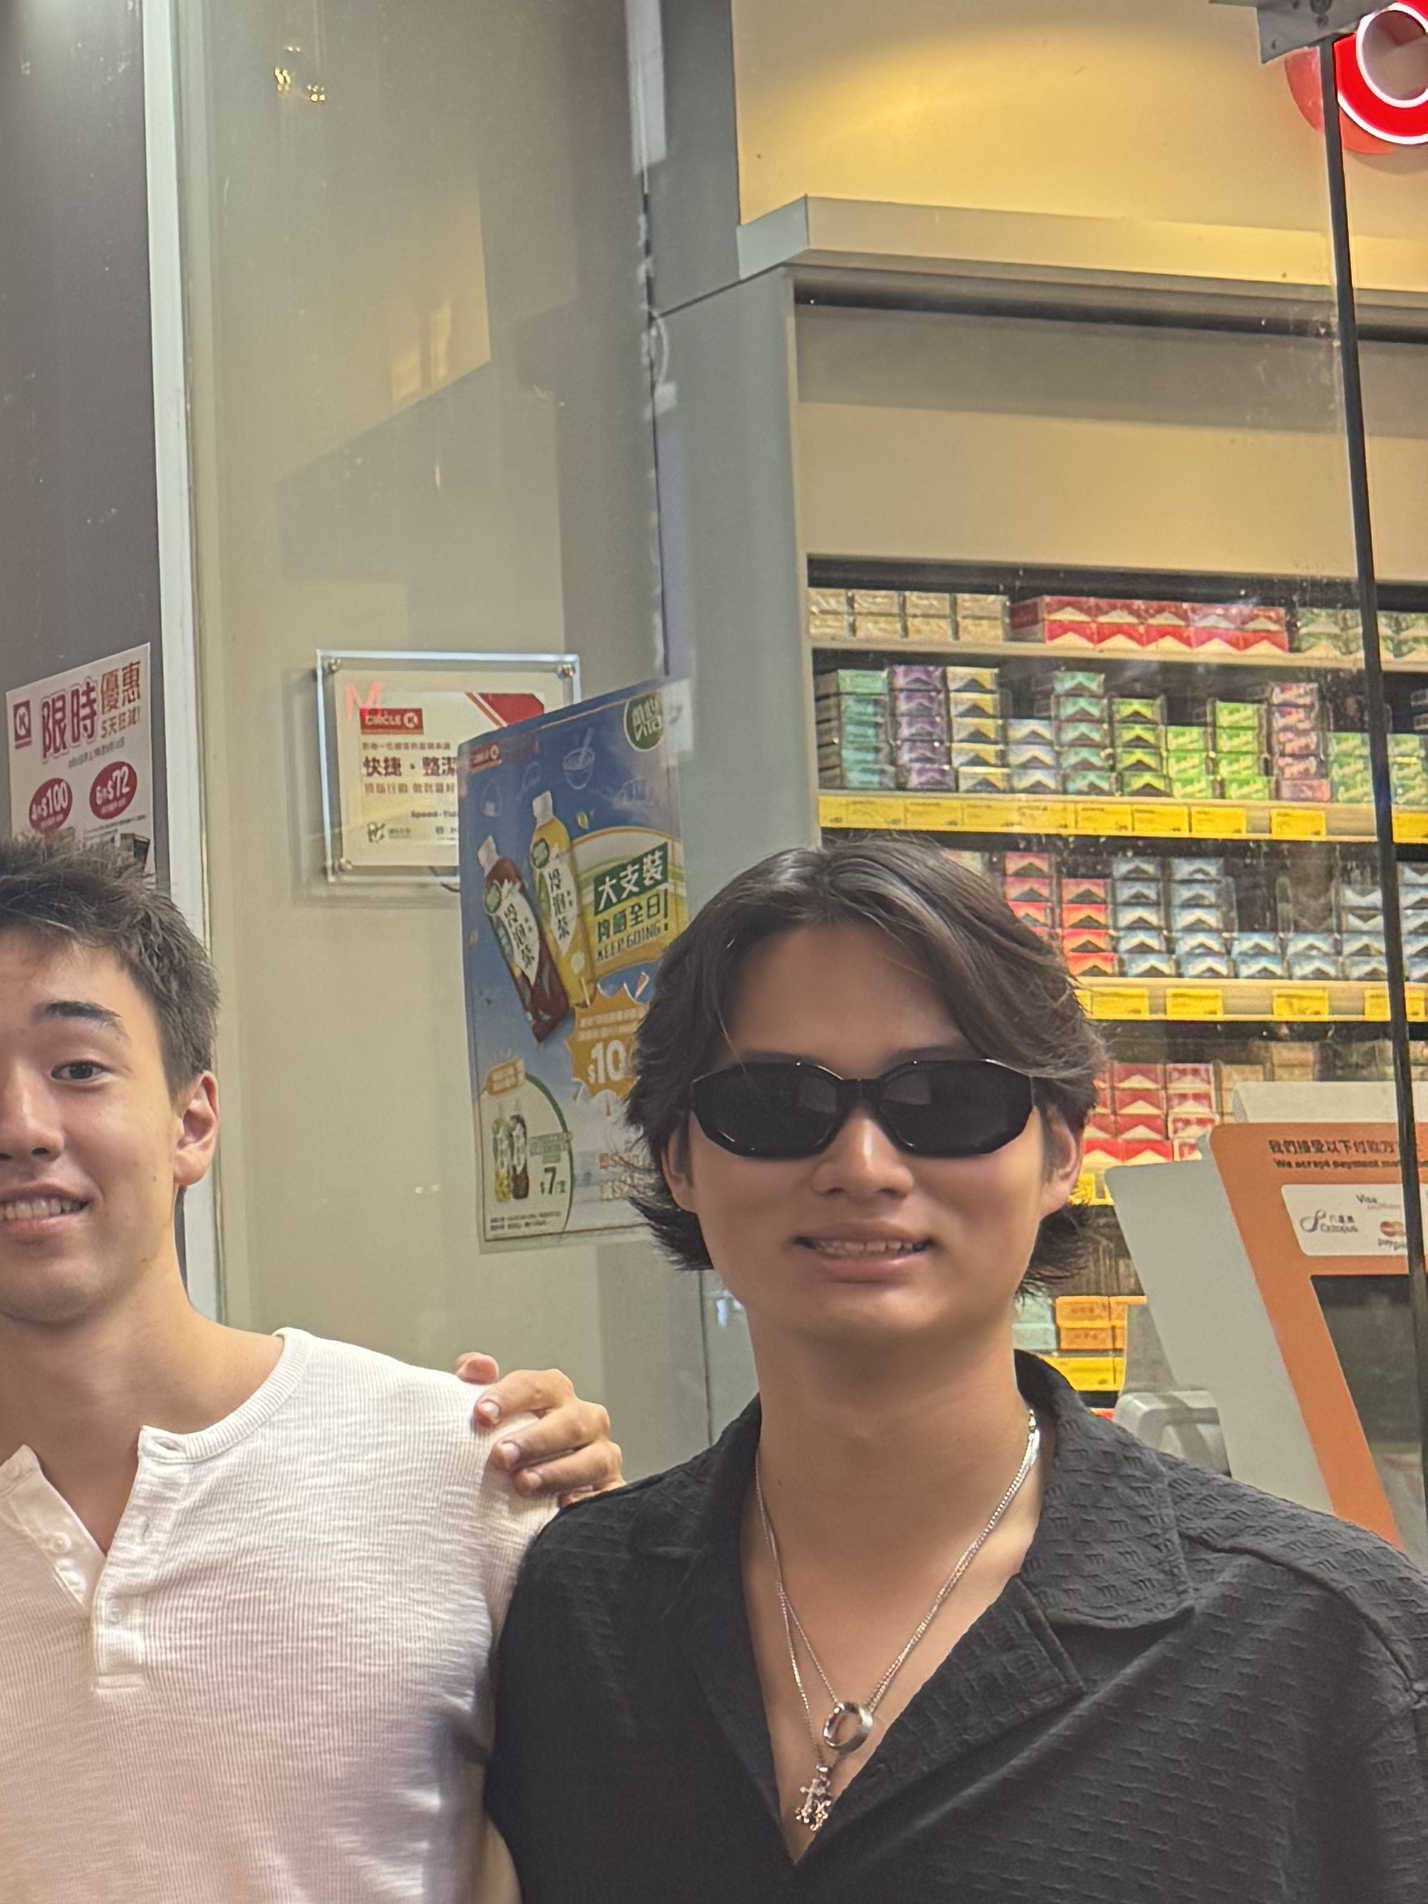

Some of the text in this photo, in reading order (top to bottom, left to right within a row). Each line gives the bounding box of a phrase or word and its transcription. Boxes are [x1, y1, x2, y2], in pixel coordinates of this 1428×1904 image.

[41, 680, 97, 758] 限時
[101, 661, 141, 715] 優惠
[597, 849, 664, 911] 大支裝
